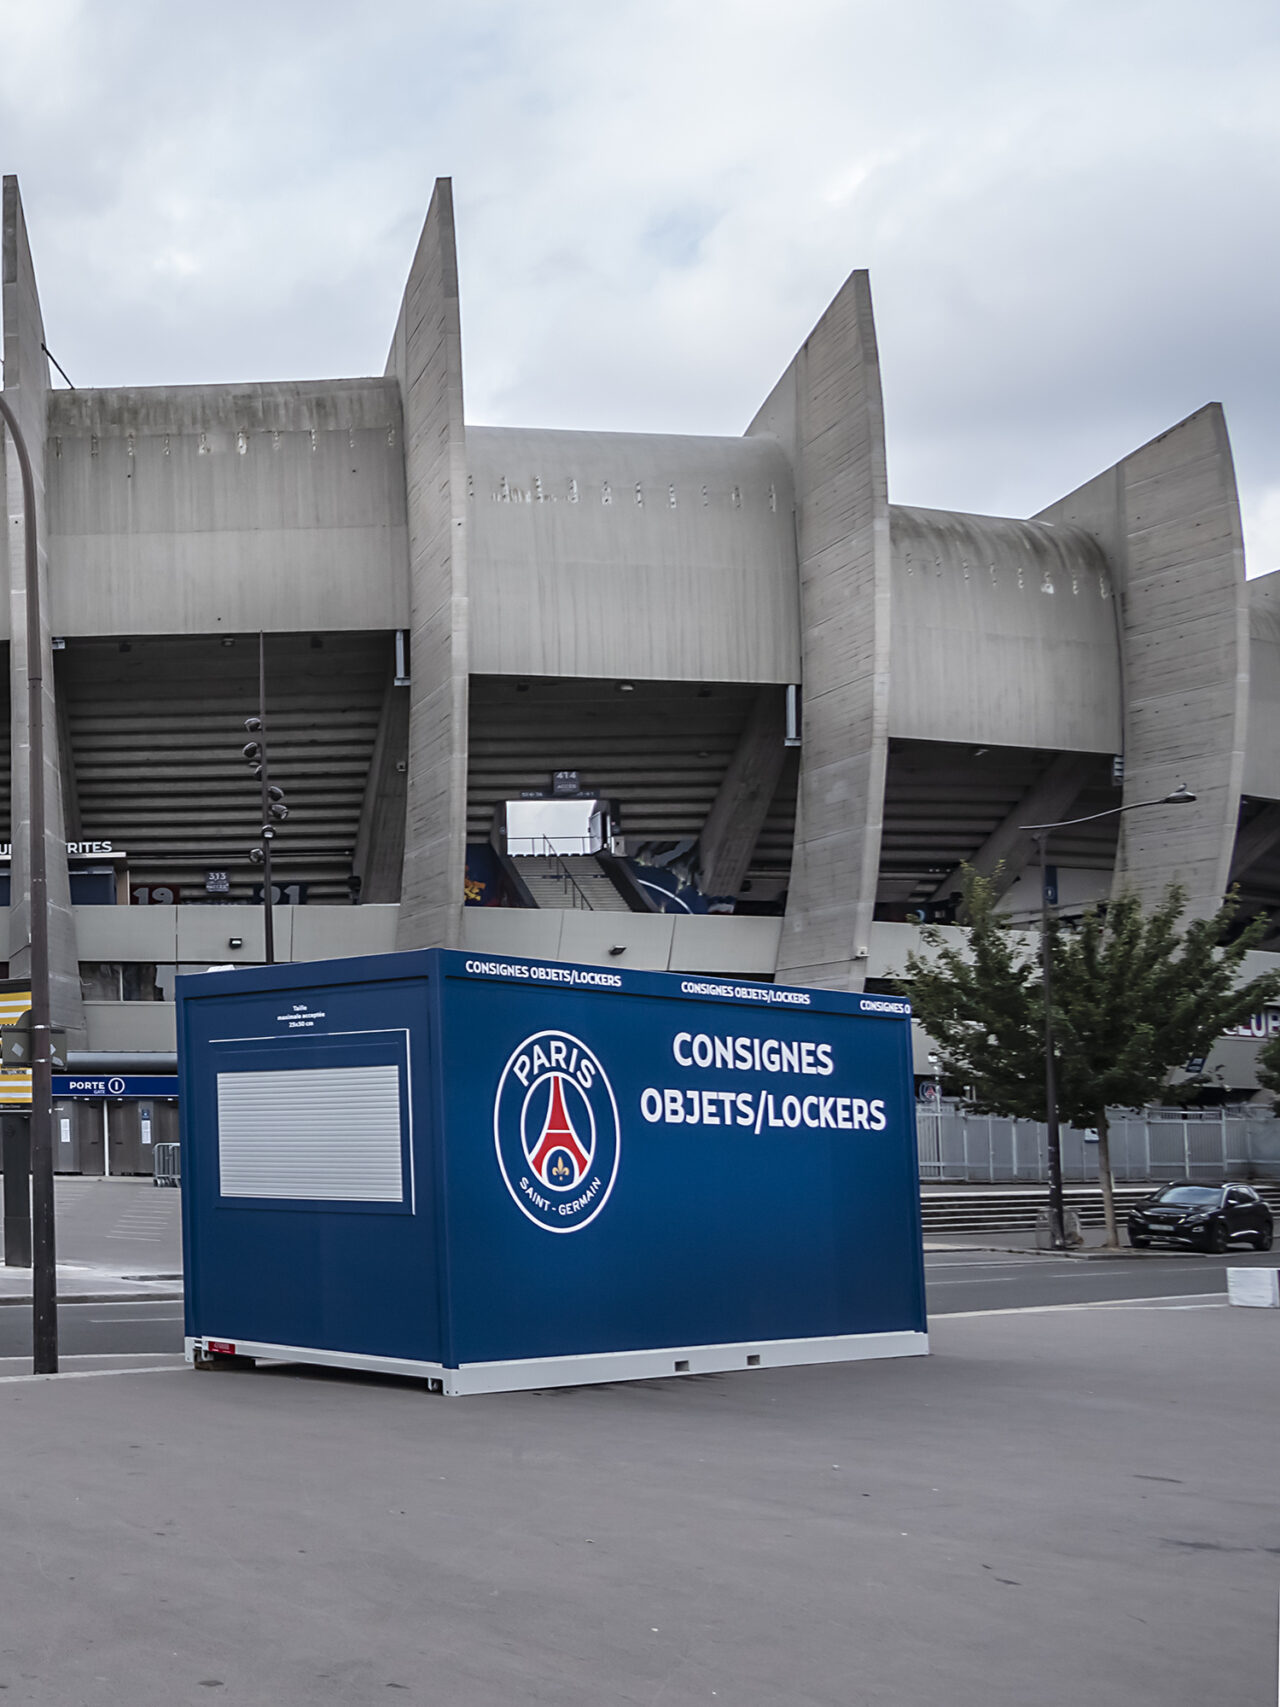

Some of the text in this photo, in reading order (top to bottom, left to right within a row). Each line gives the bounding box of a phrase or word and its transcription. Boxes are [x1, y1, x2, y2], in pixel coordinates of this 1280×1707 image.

[66, 841, 112, 854] RITES
[209, 872, 226, 880] 313
[465, 960, 622, 987] CONSIGNES OBJETS/LOCKERS
[681, 981, 811, 1004] CONSIGNES OBJETS/LOCKERS
[860, 1000, 904, 1013] CONSIGNES
[513, 1041, 596, 1089] PARIS
[673, 1032, 834, 1076] CONSIGNES
[640, 1087, 887, 1135] OBJETS/LOCKERS
